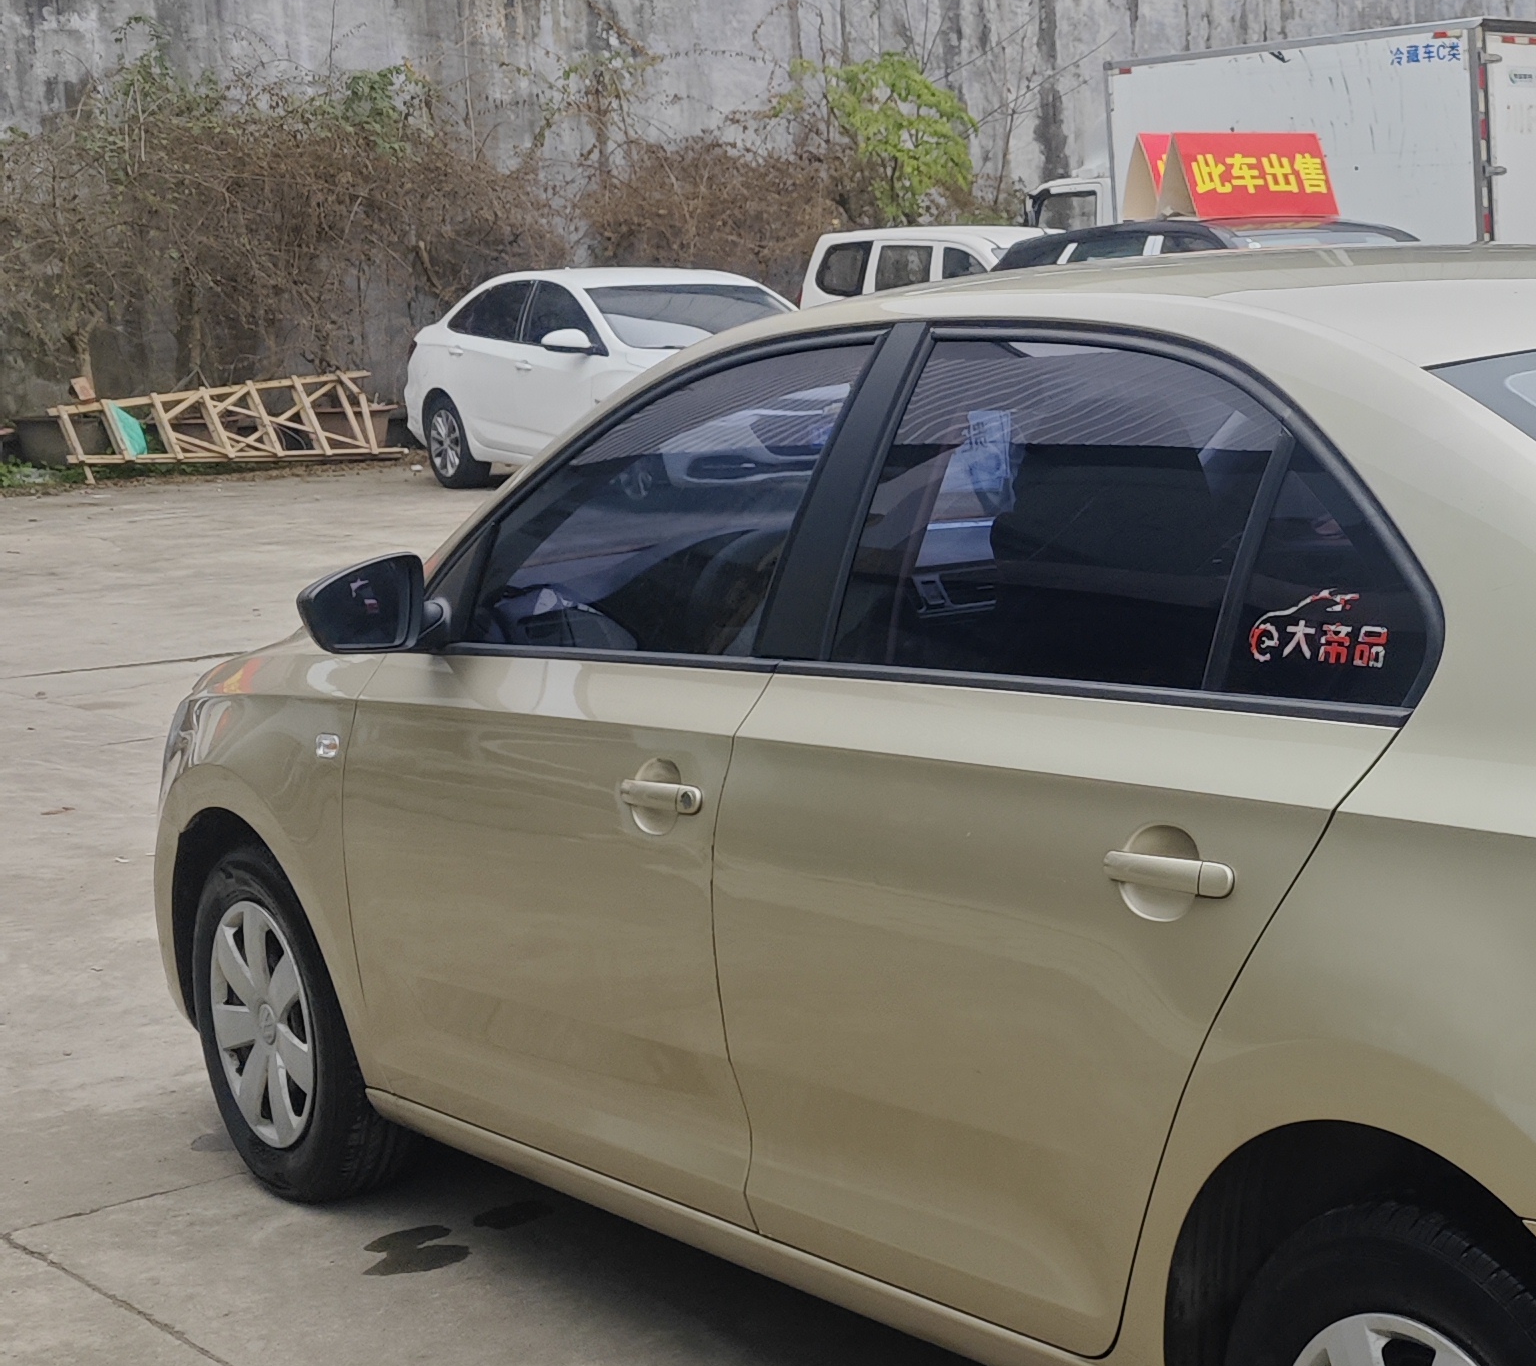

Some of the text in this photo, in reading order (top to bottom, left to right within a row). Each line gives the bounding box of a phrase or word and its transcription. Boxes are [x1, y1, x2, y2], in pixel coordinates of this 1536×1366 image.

[1390, 41, 1461, 66] 冷藏车C类
[1191, 153, 1328, 194] 此车出售
